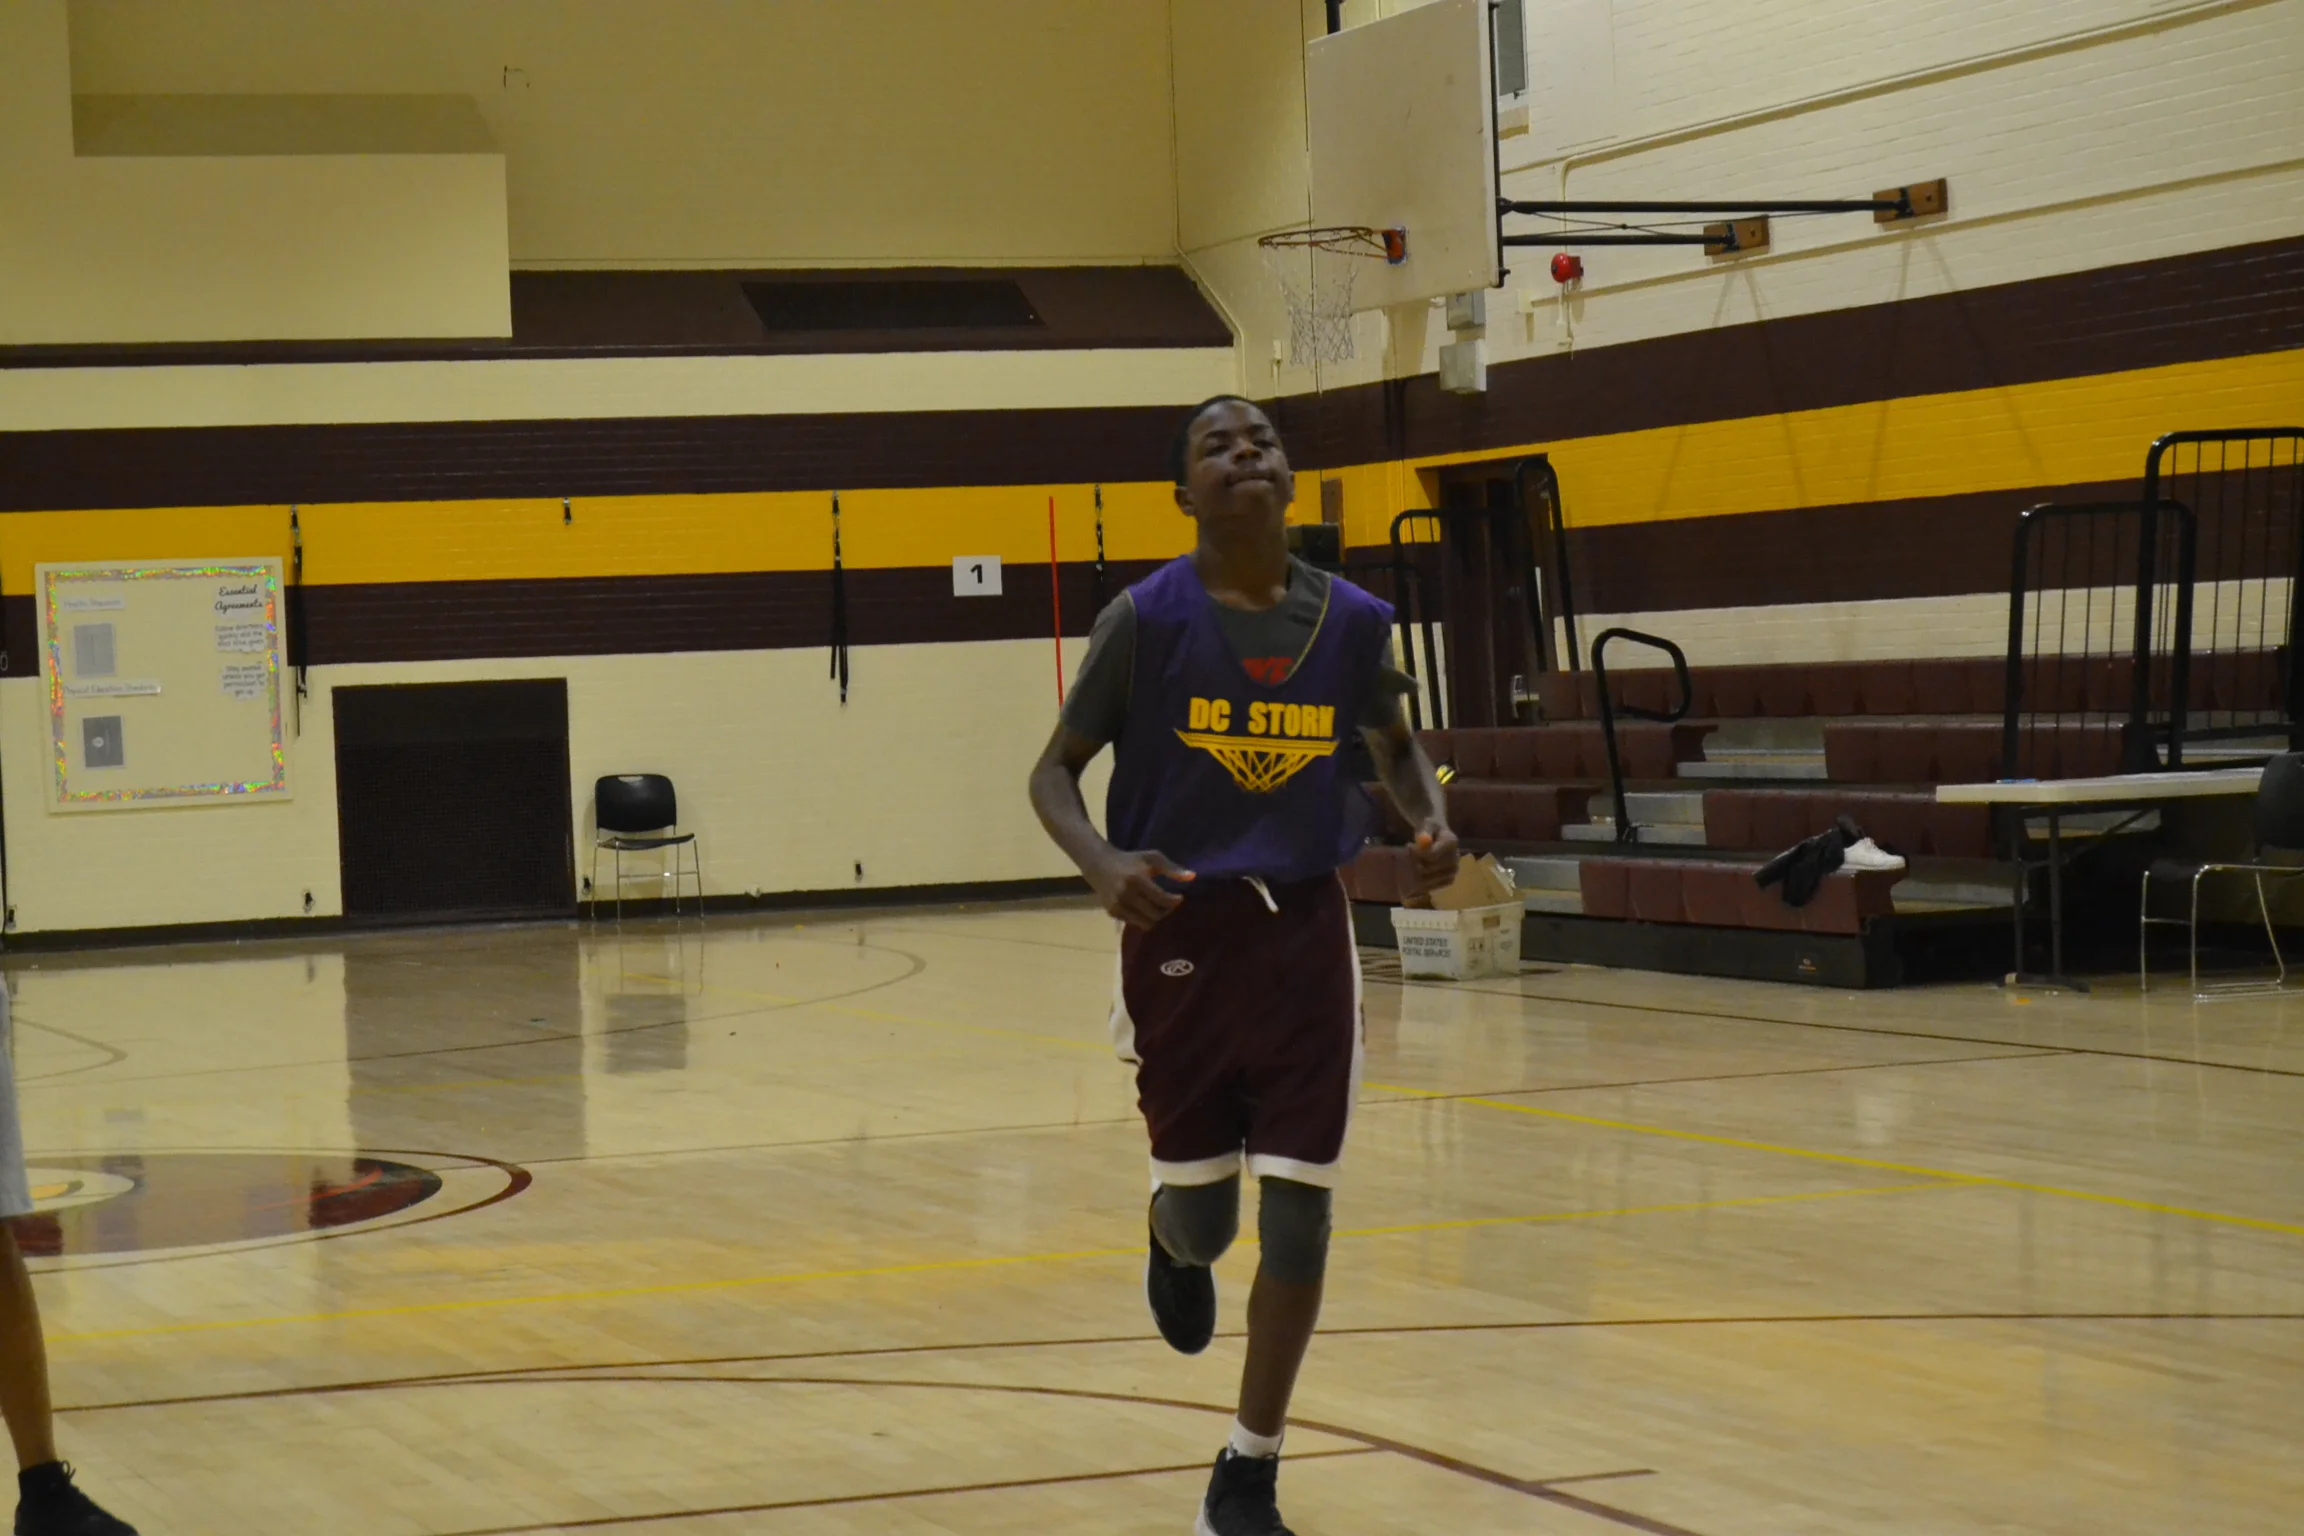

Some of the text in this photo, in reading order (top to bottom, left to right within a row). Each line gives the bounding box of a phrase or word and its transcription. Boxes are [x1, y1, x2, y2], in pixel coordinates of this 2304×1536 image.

[970, 563, 983, 584] 1
[218, 584, 257, 596] Essential
[215, 599, 263, 614] Agreements
[1188, 697, 1336, 738] DC STORM
[1403, 935, 1448, 948] UNITED STATES
